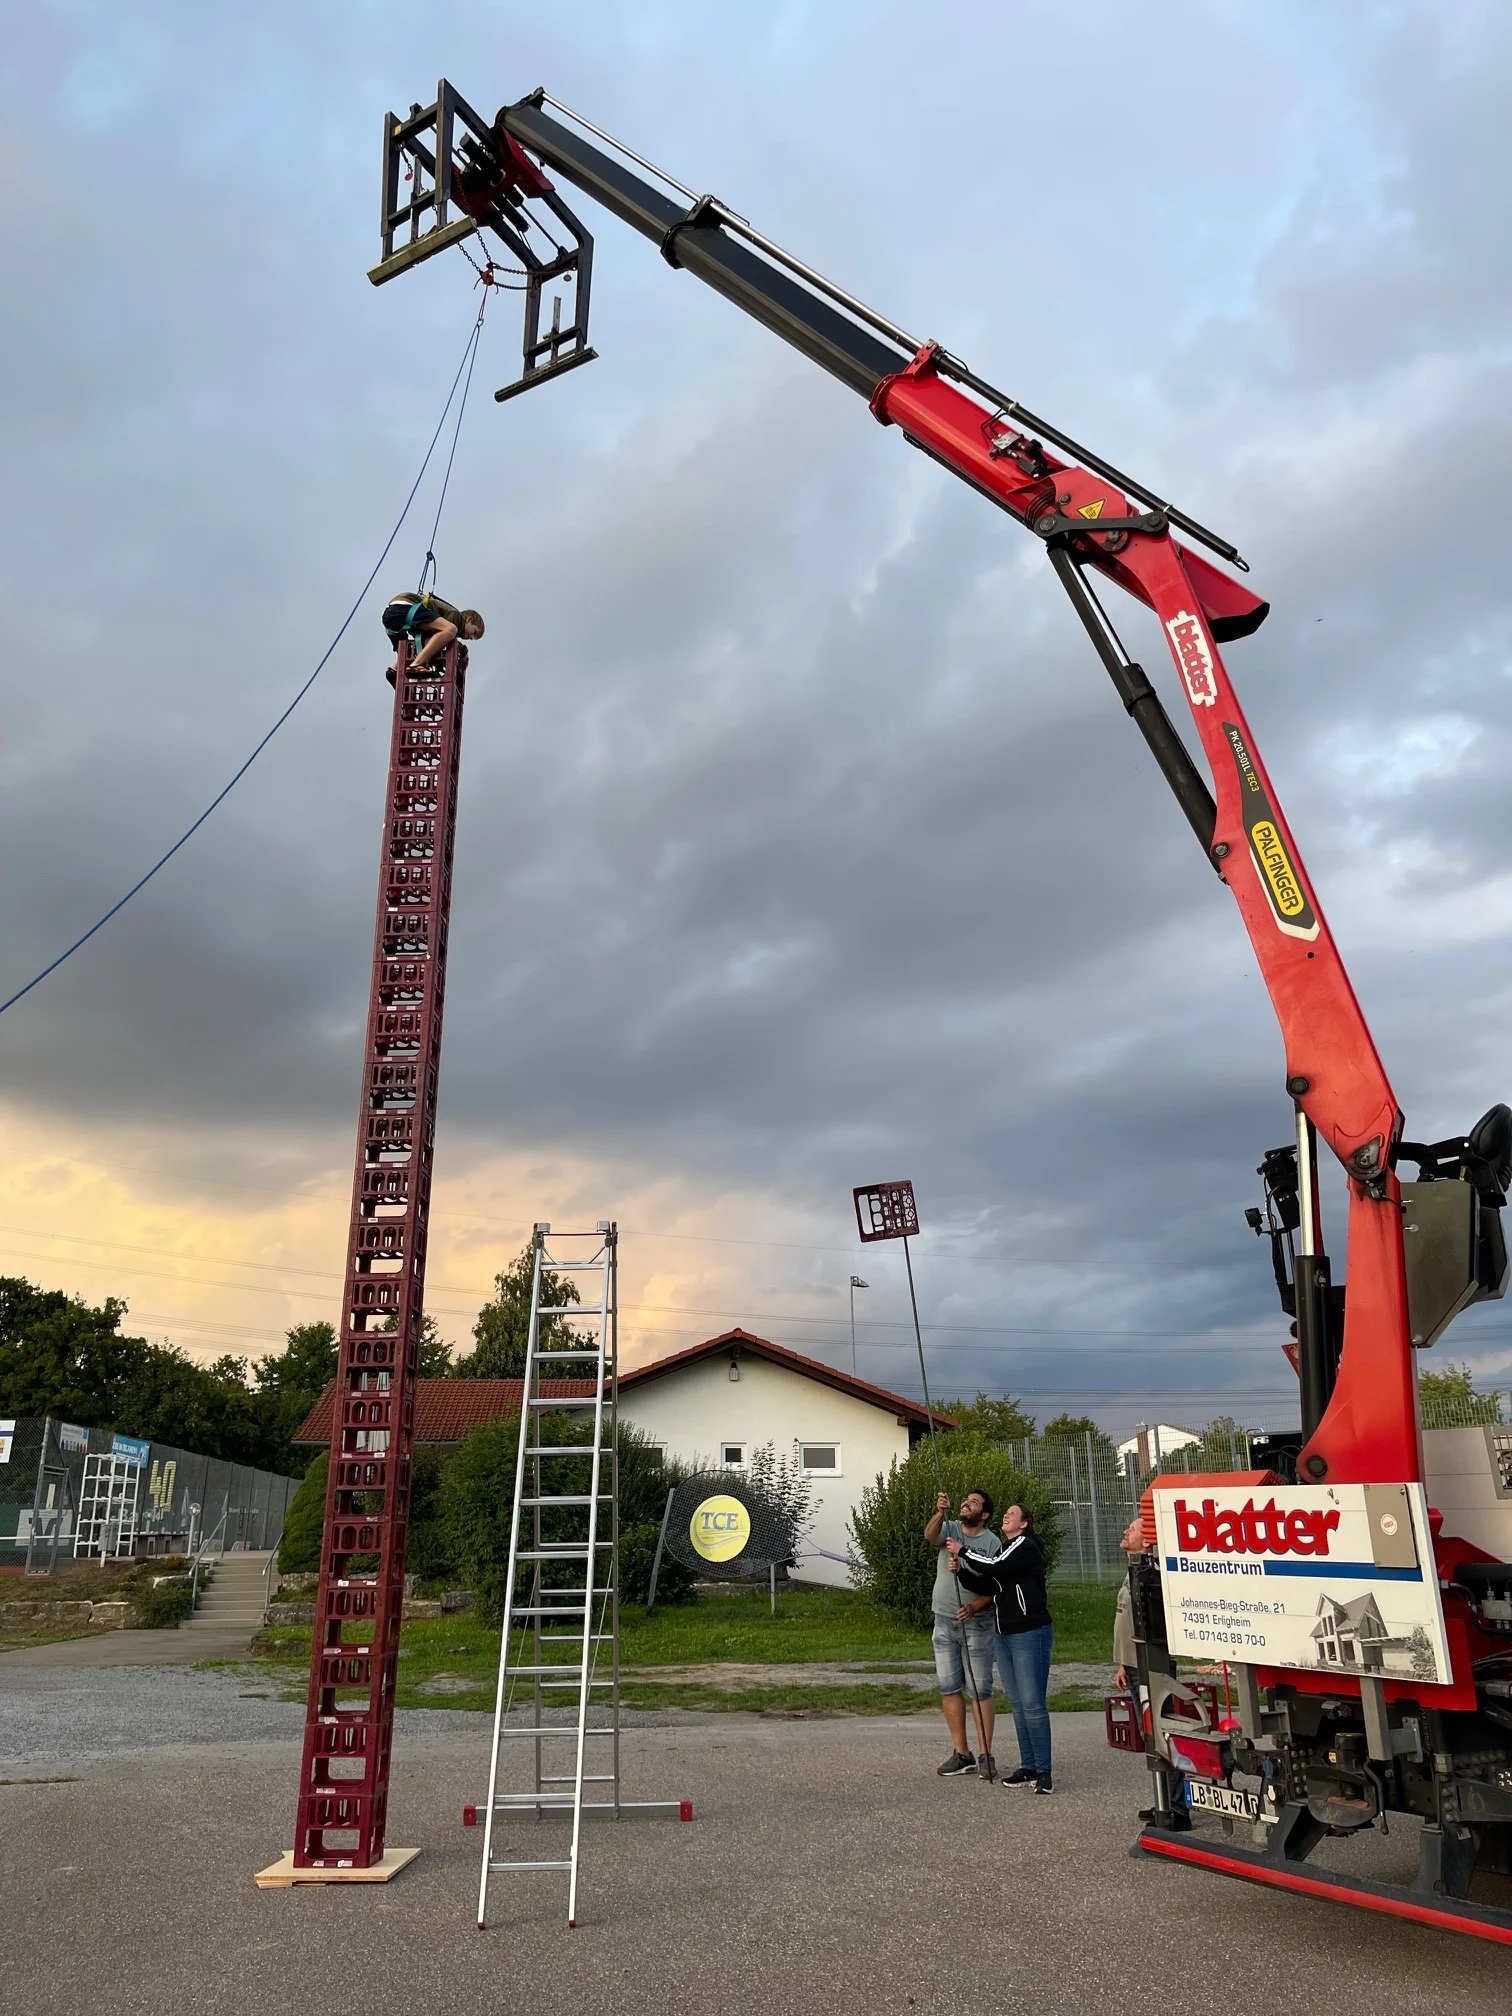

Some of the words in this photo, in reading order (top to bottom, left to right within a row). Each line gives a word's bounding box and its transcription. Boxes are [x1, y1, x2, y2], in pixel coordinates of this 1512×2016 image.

[1173, 620, 1212, 697] blatter
[1229, 730, 1240, 743] PK
[1255, 826, 1299, 911] PALFINGER
[701, 1512, 739, 1531] TCE
[1173, 1497, 1341, 1556] blatter
[1180, 1557, 1262, 1576] Bauzentrum
[1273, 1602, 1286, 1613] 21
[1182, 1612, 1210, 1624] 74391
[1212, 1614, 1251, 1629] Erligheim
[1183, 1629, 1198, 1640] Tel.
[1199, 1630, 1229, 1643] 07143
[1230, 1633, 1243, 1644] 88
[1245, 1634, 1266, 1647] 70-0
[1191, 1784, 1206, 1805] LB
[1212, 1789, 1229, 1811] BL
